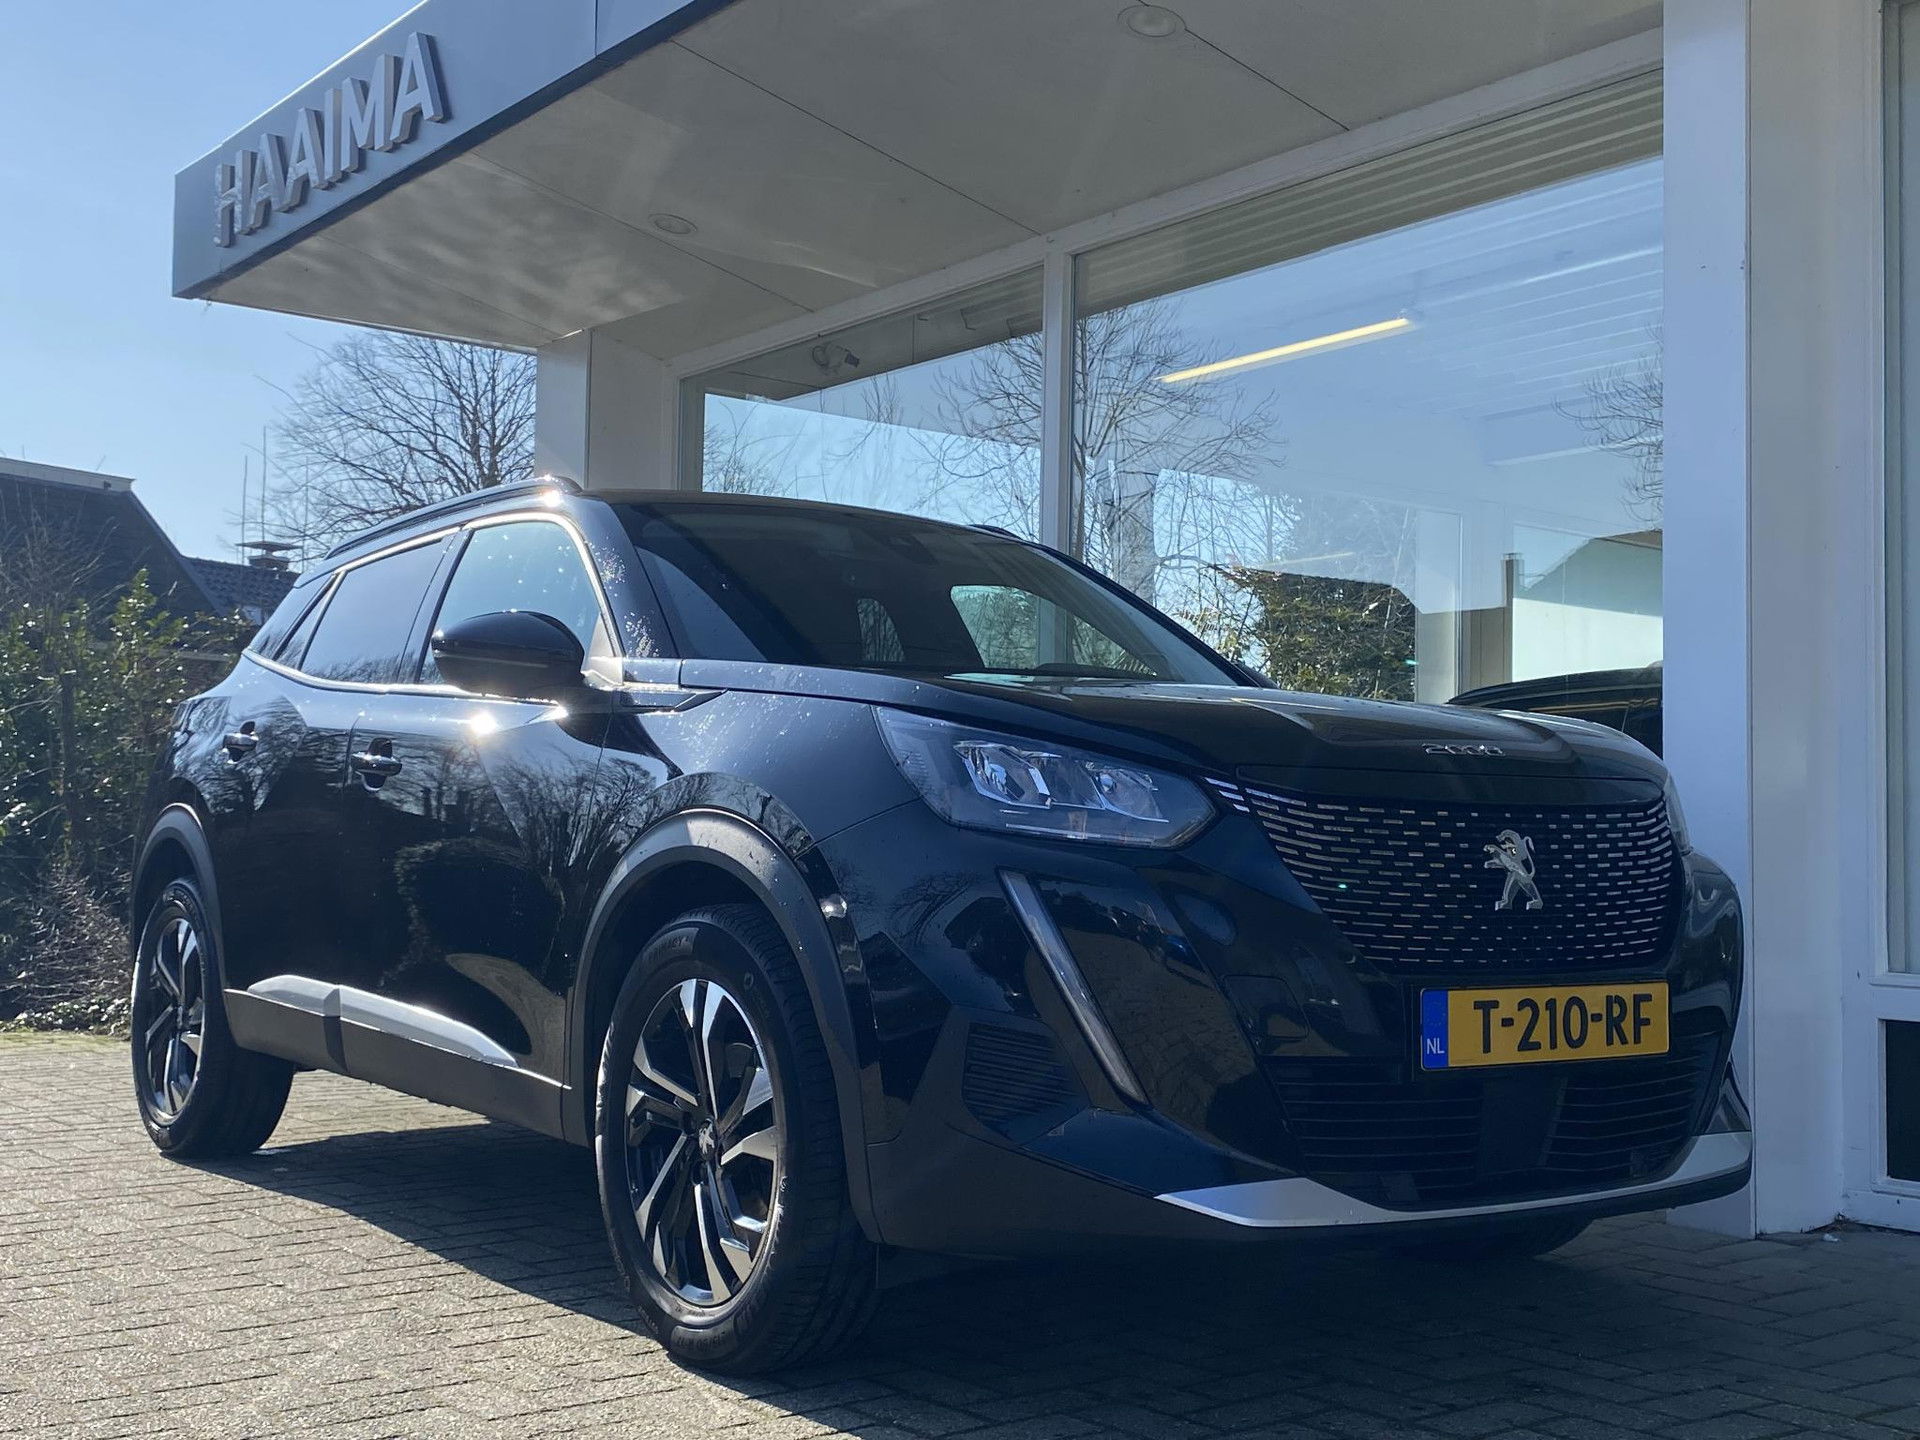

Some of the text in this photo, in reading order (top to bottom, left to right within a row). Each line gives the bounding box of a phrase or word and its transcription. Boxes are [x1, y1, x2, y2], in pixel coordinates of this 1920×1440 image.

[214, 31, 446, 248] HAAIMA
[1426, 1037, 1445, 1055] NL
[1473, 993, 1653, 1054] T-210-RF
